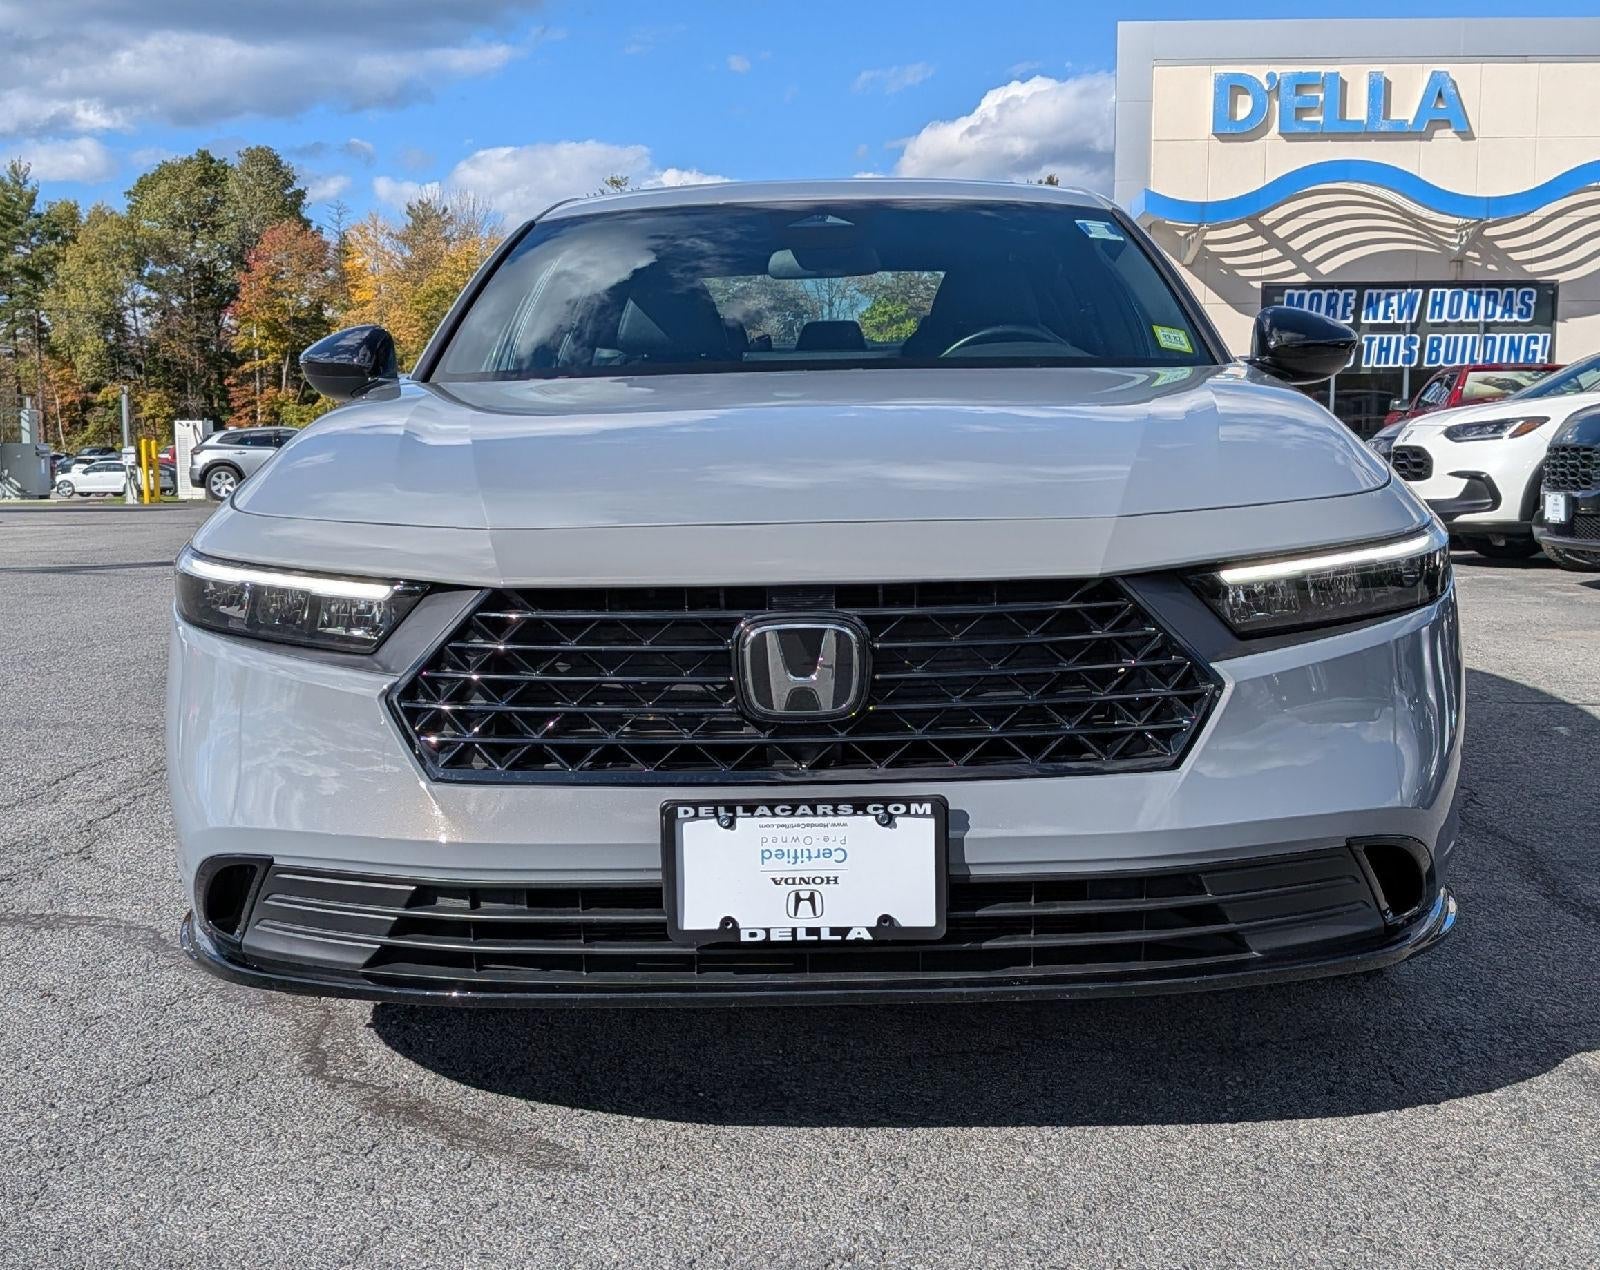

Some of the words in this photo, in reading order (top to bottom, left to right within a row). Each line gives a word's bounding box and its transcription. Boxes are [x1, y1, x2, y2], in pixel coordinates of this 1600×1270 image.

[1212, 70, 1470, 135] D'ELLA
[1361, 288, 1423, 323] NEW
[1427, 287, 1537, 323] HONDAS
[1361, 333, 1420, 368] THIS
[1424, 333, 1551, 366] BUILDING!
[677, 802, 932, 819] DELLACARS.COM
[761, 835, 847, 846] Pre-Owned
[761, 847, 848, 865] Certified
[770, 876, 840, 886] HONDA
[739, 927, 874, 942] DELLA
